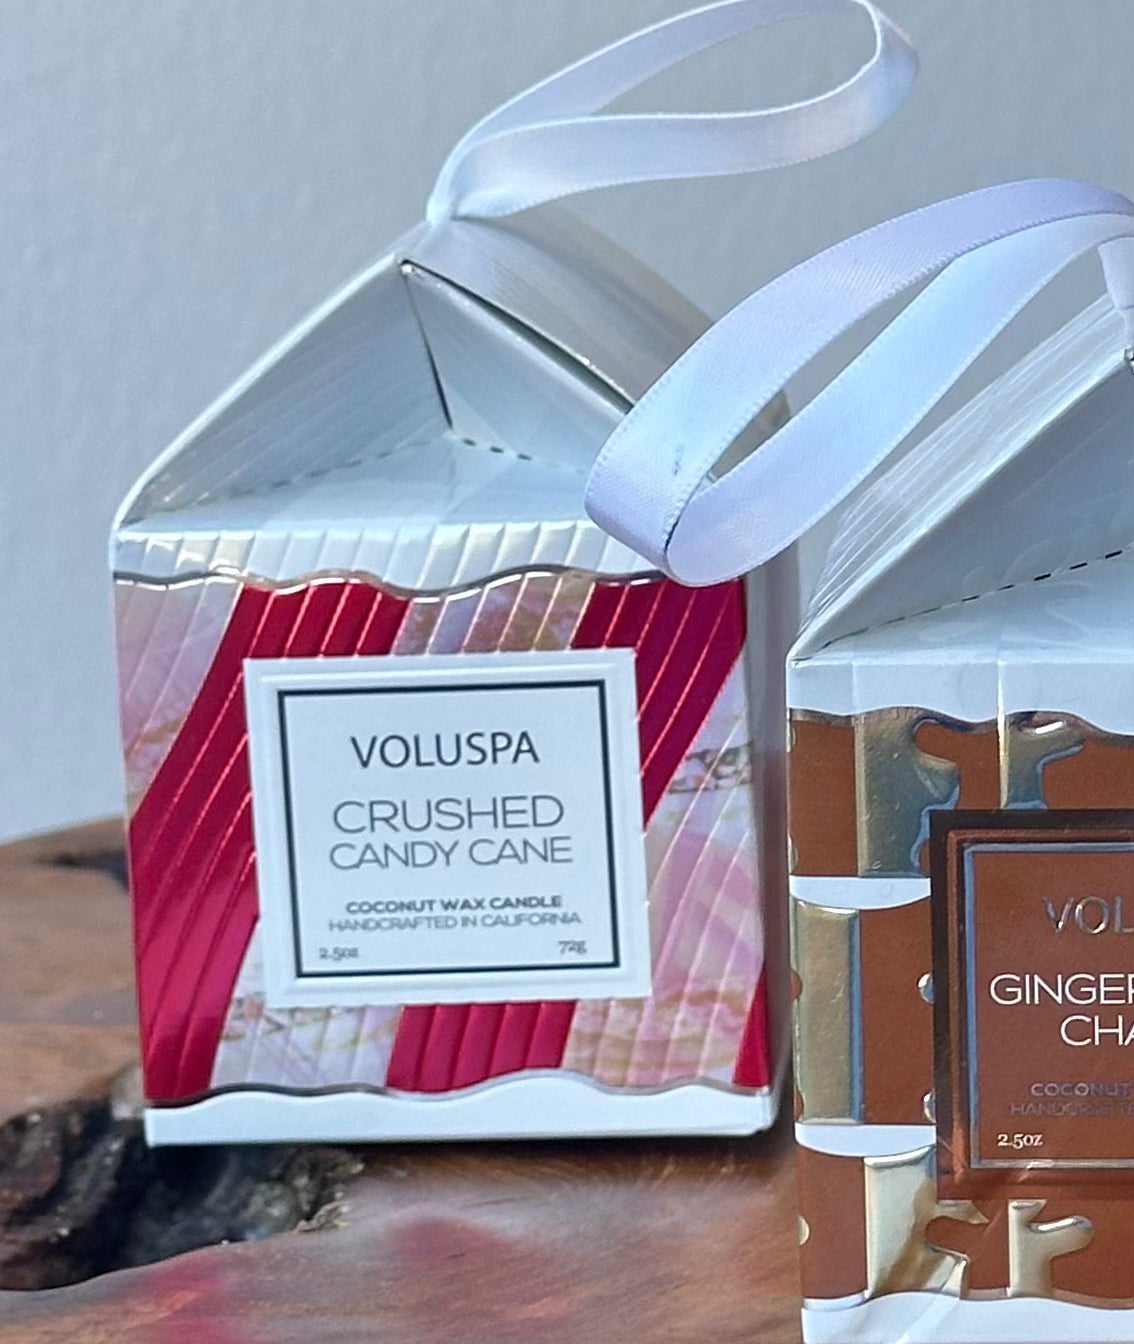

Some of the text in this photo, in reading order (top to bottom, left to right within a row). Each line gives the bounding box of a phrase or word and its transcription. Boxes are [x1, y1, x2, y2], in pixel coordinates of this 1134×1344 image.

[350, 730, 540, 769] VOLUSPA
[333, 795, 564, 834] CRUSHED
[329, 836, 573, 871] CANDY CANE
[346, 896, 562, 914] COCONUT WAX CANDLE
[329, 912, 581, 932] HANDCRAFTED IN CALIFORNIA
[558, 940, 586, 955] 72g
[1031, 1082, 1129, 1097] COCONUT
[998, 1133, 1043, 1149] 2.5oz
